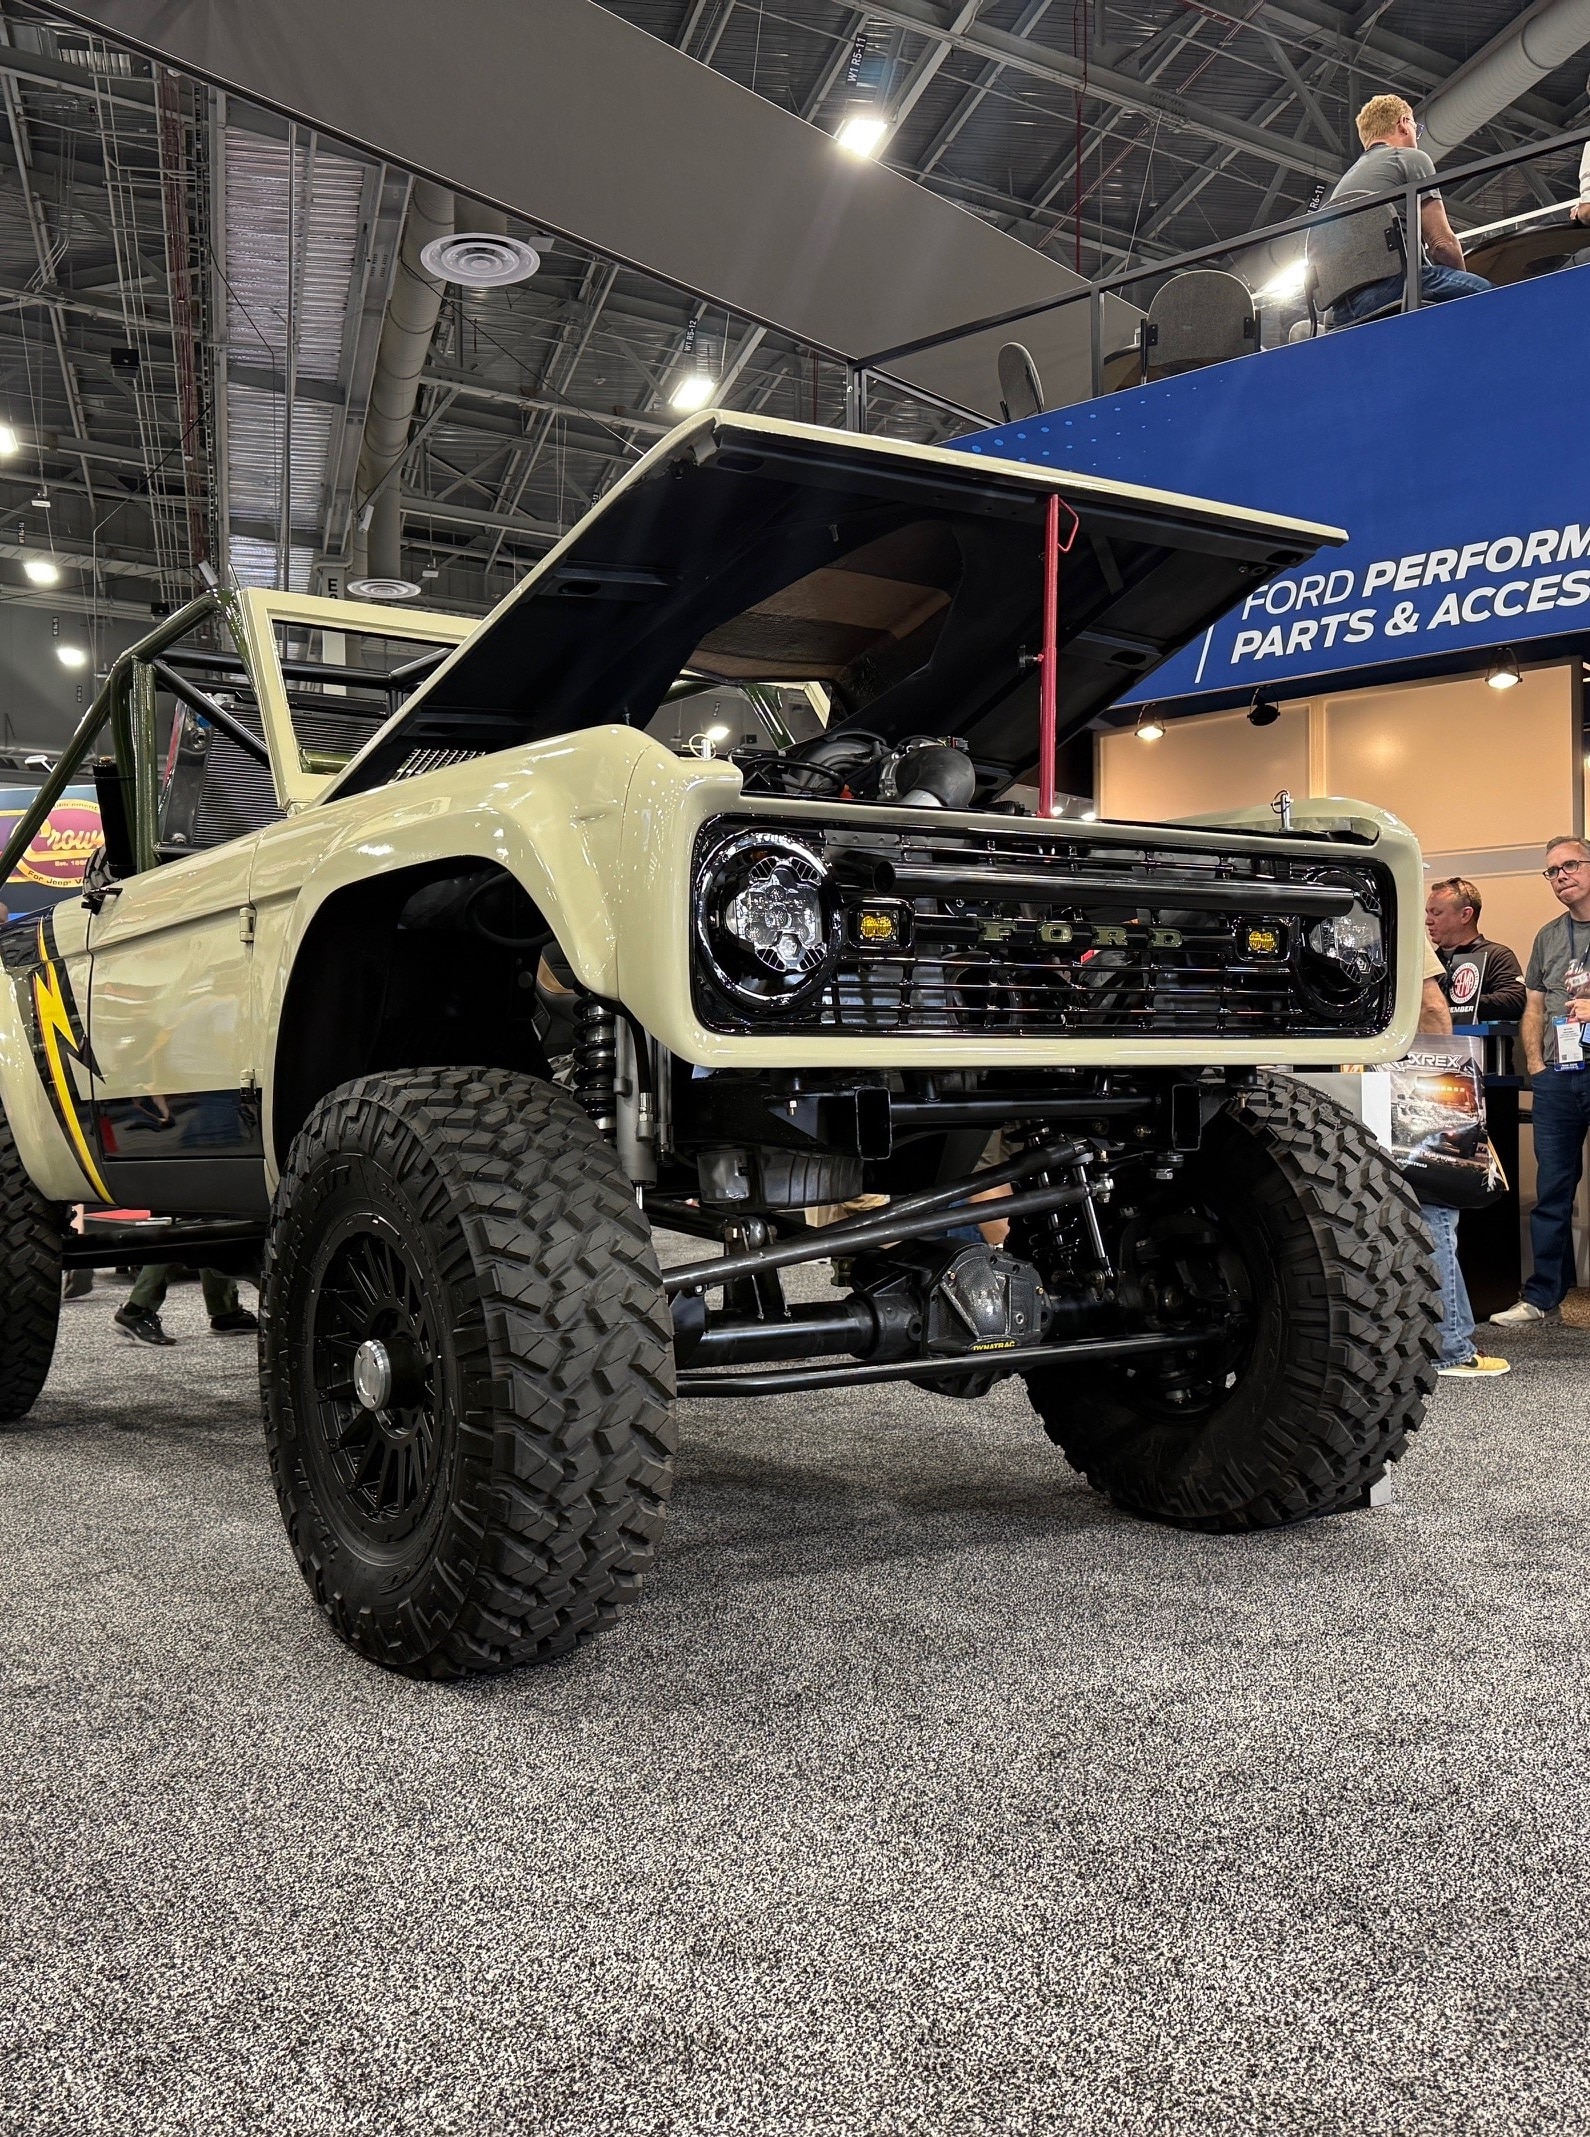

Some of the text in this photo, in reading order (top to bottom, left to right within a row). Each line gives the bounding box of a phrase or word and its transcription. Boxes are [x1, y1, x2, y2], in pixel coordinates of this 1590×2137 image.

[847, 37, 866, 82] W1 R5-11
[1309, 185, 1326, 209] R6-11
[328, 578, 338, 592] E
[1241, 523, 1590, 621] FORD PERFORM
[1230, 569, 1590, 664] PARTS & ACCES
[27, 870, 44, 881] For
[978, 919, 1183, 948] FORD
